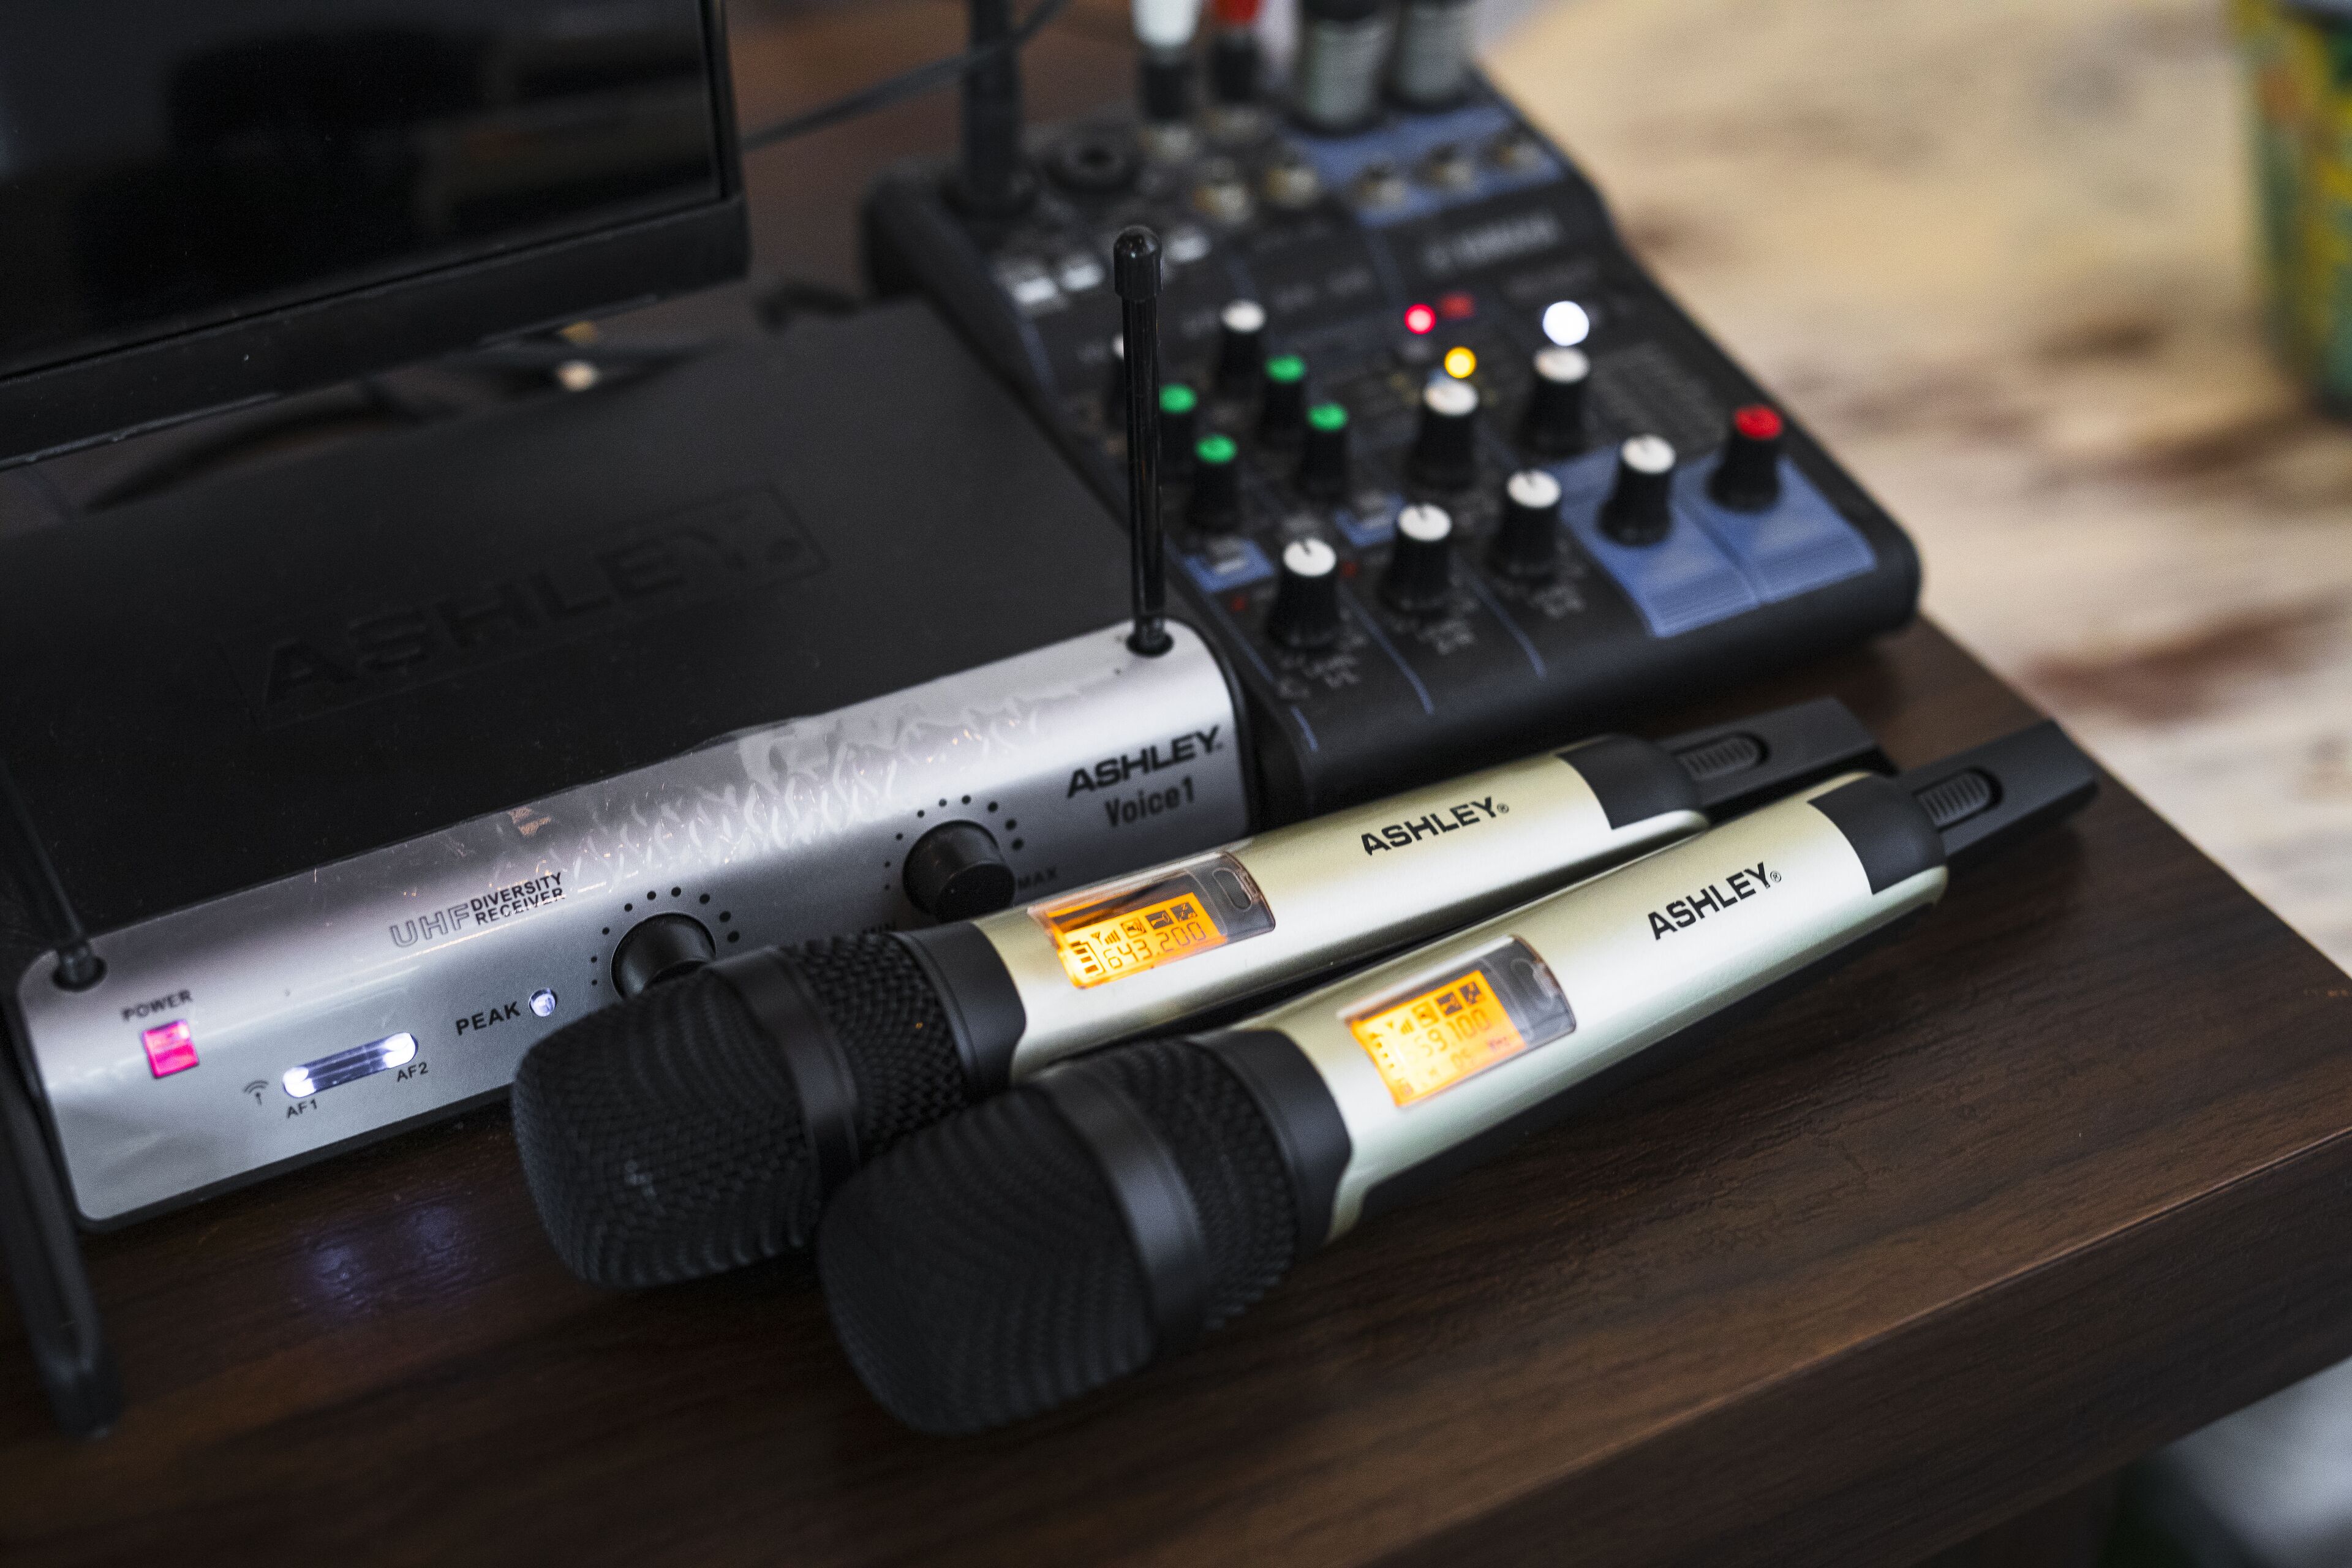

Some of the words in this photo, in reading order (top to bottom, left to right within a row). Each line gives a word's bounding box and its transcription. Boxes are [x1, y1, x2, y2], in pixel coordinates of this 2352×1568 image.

[1066, 725, 1220, 799] ASHLEY
[1104, 776, 1194, 827] Voice1
[1361, 796, 1497, 856] ASHLEY
[1017, 864, 1058, 889] MAX
[389, 903, 470, 948] UHF
[470, 872, 562, 913] DIVERSITY
[475, 888, 565, 925] RECEIVER
[1648, 861, 1771, 940] ASHLEY
[1102, 921, 1207, 970] 643.200
[121, 989, 193, 1022] POWER
[456, 1001, 521, 1035] PEAK
[396, 1061, 429, 1082] AF2
[285, 1099, 318, 1119] AF1
